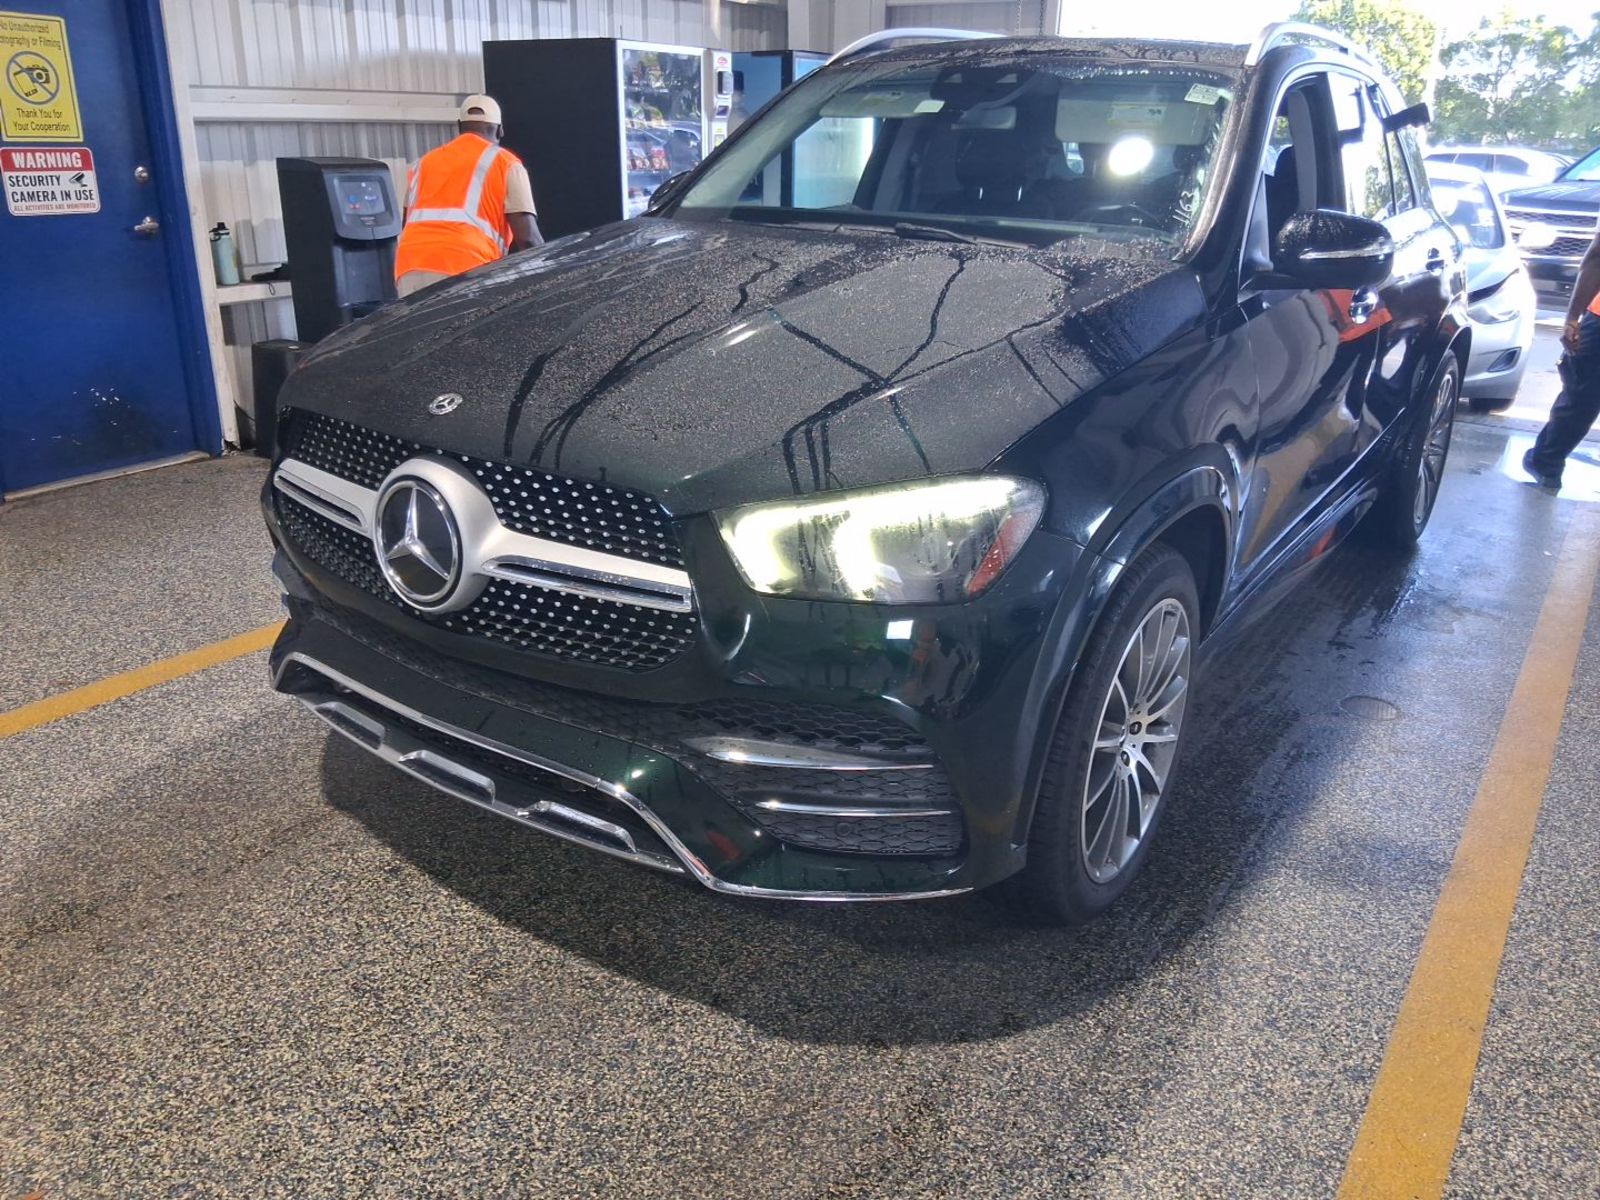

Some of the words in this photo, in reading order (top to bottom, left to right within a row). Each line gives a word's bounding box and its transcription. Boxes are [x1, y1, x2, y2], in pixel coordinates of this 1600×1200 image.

[31, 38, 38, 46] or
[39, 36, 62, 50] Filming
[16, 107, 38, 118] Thank
[38, 108, 52, 118] You
[53, 108, 63, 119] for
[13, 121, 29, 131] Your
[30, 121, 71, 132] Cooperation
[11, 151, 83, 169] WARNING
[8, 175, 61, 188] SECURITY
[11, 191, 58, 203] CAMERA
[60, 190, 72, 201] IN
[75, 189, 95, 201] USE
[25, 204, 54, 212] ACTIVITIES
[66, 202, 97, 210] MONITORED
[1172, 190, 1195, 224] 1163
